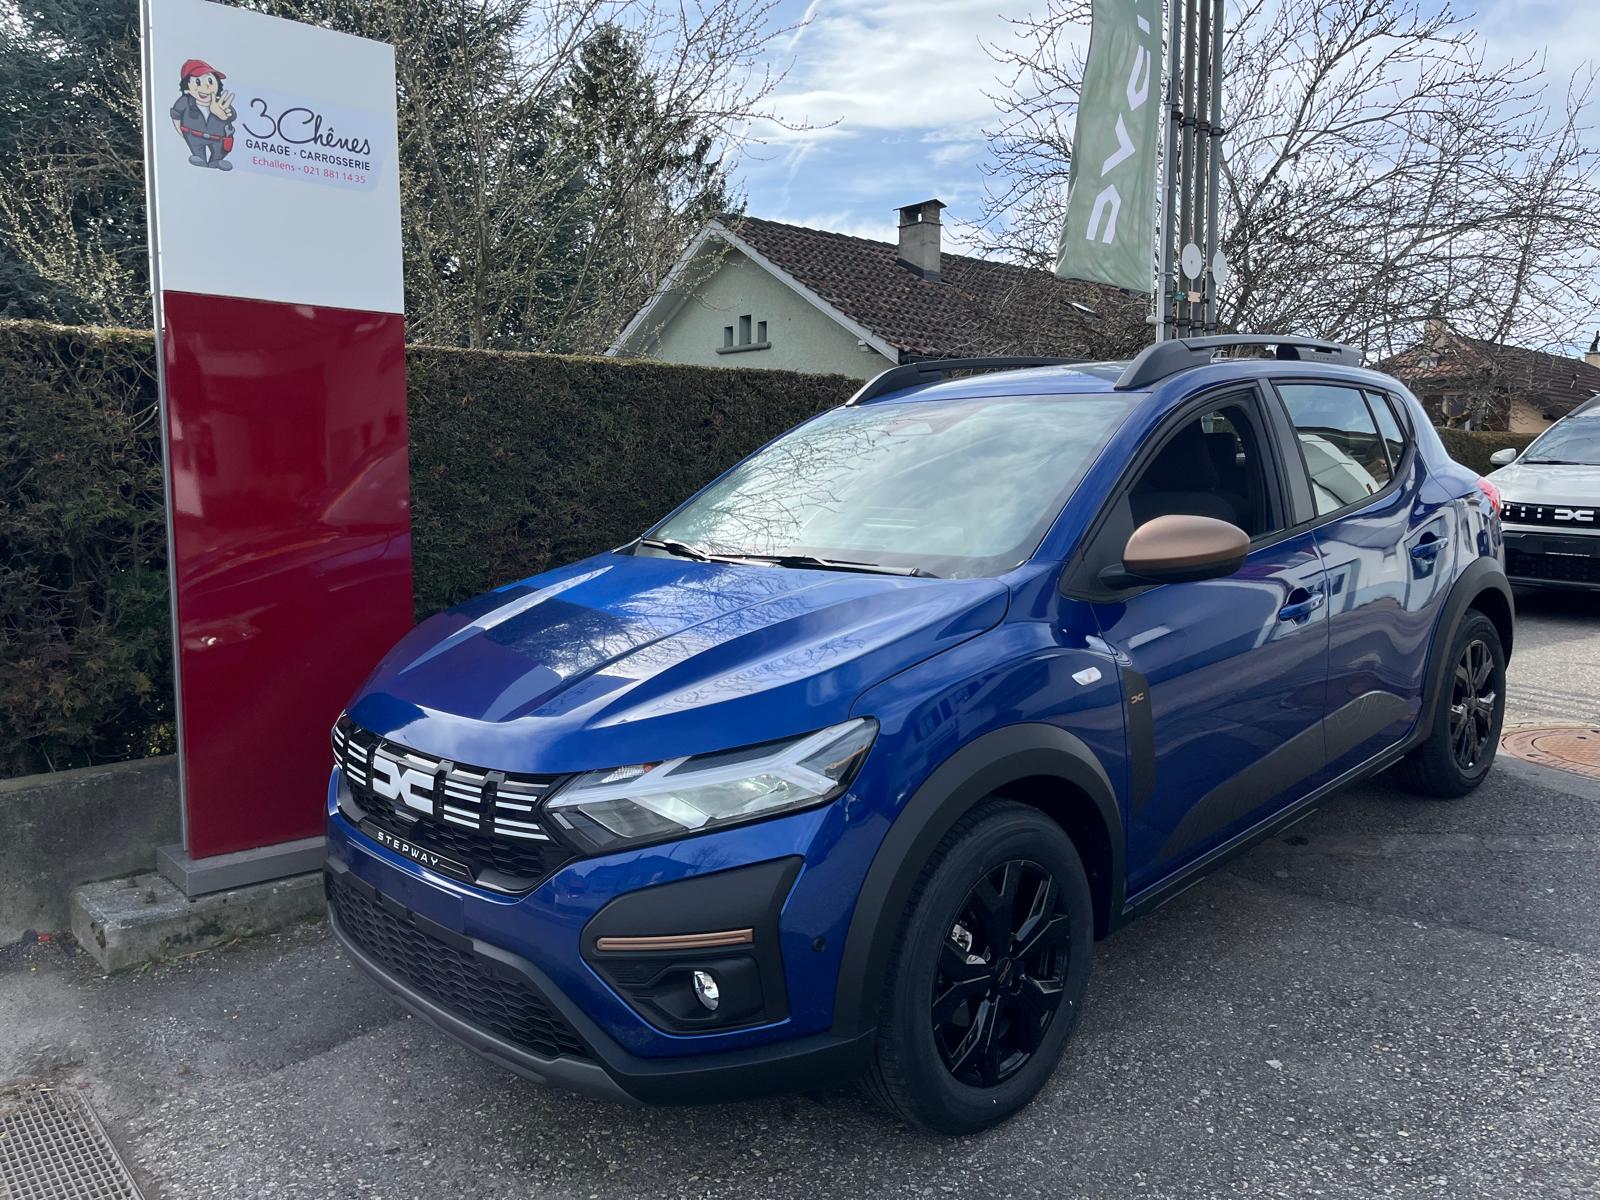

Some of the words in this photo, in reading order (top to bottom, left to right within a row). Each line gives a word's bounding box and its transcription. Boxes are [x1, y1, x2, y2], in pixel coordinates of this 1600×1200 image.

[245, 139, 290, 156] GARAGE
[299, 149, 371, 171] CARROSSERIE
[252, 156, 295, 172] Echallens
[303, 165, 320, 176] 021
[323, 169, 339, 179] 881
[377, 831, 439, 866] STEPWAY
